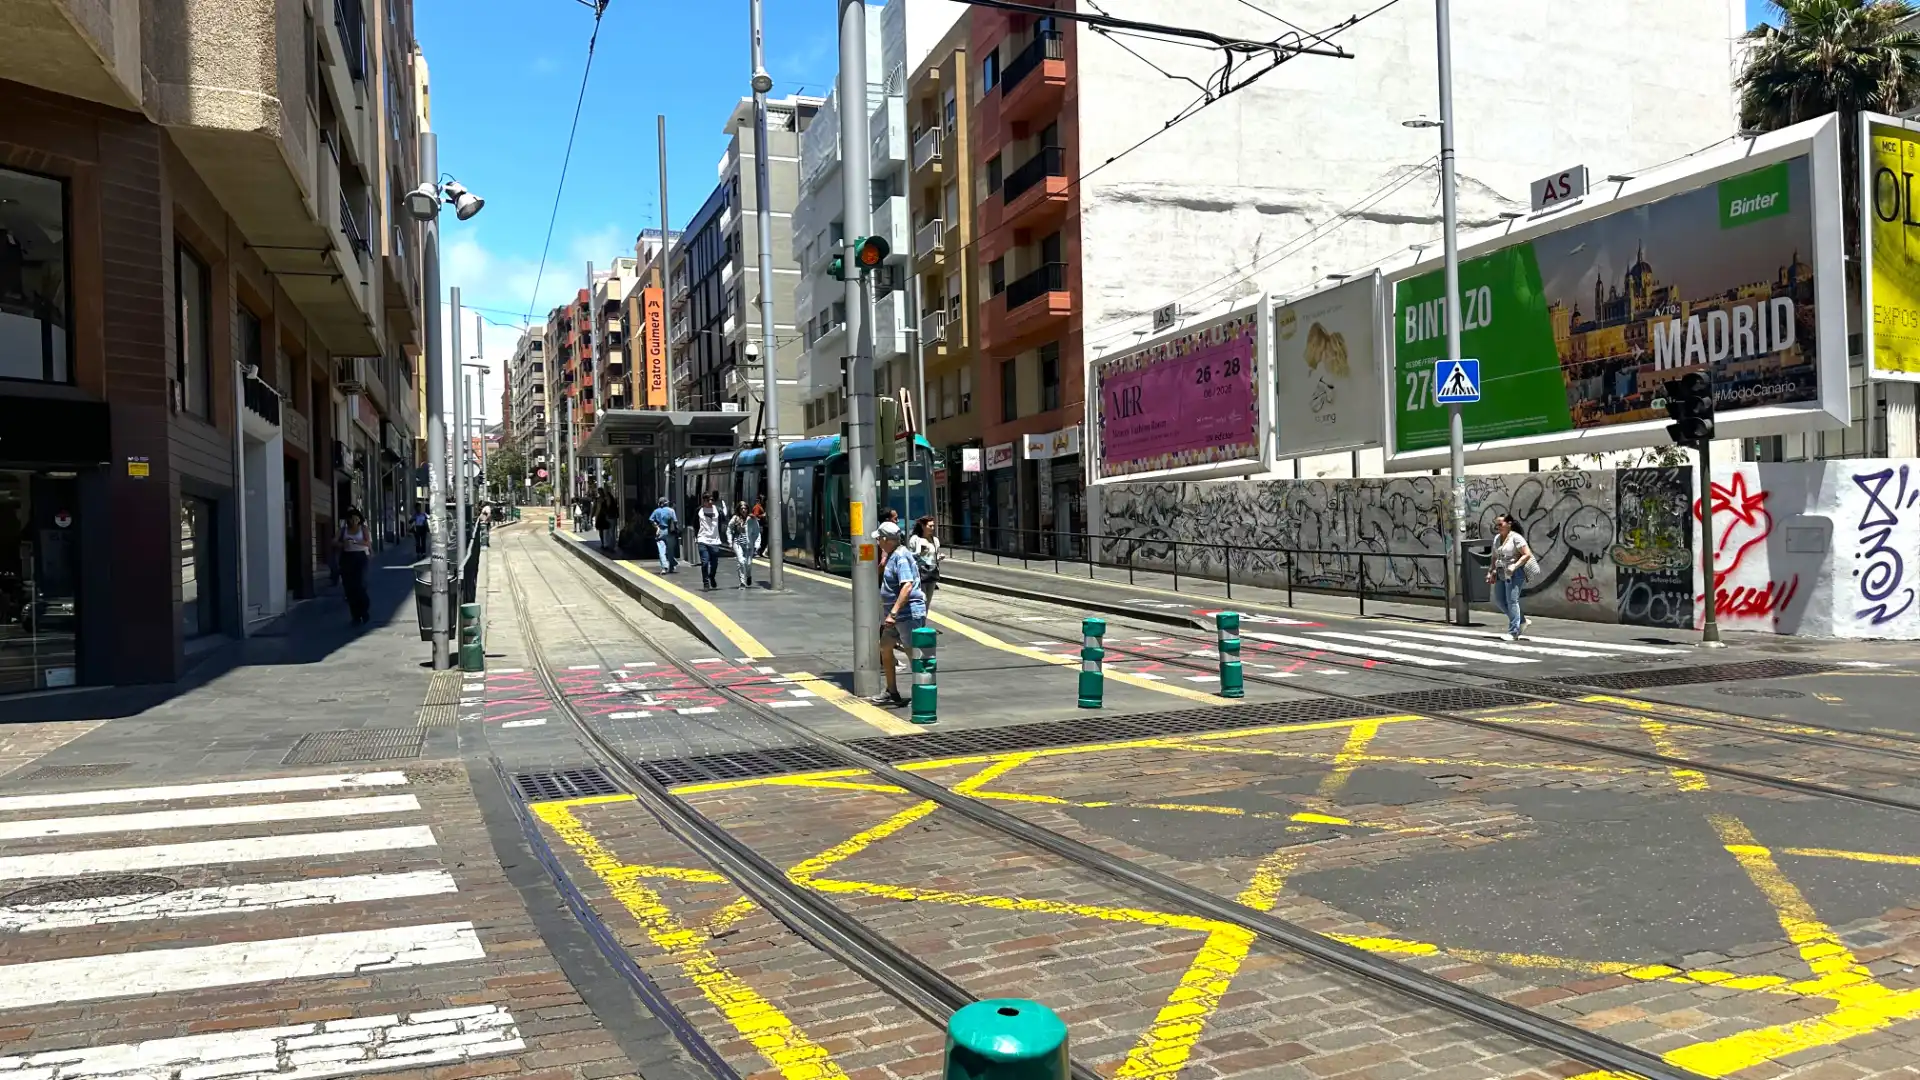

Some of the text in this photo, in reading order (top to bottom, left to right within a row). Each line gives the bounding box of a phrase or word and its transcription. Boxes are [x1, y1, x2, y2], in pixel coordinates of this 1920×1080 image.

[1881, 140, 1897, 153] MCC
[1541, 173, 1571, 206] AS
[1729, 191, 1779, 218] Binter
[1157, 307, 1171, 326] AS
[1653, 296, 1796, 371] MADRID
[648, 311, 662, 392] Teatro Guimerá
[1195, 364, 1212, 385] 26
[1222, 356, 1241, 379] 28
[1713, 381, 1796, 401] #ModoCanario
